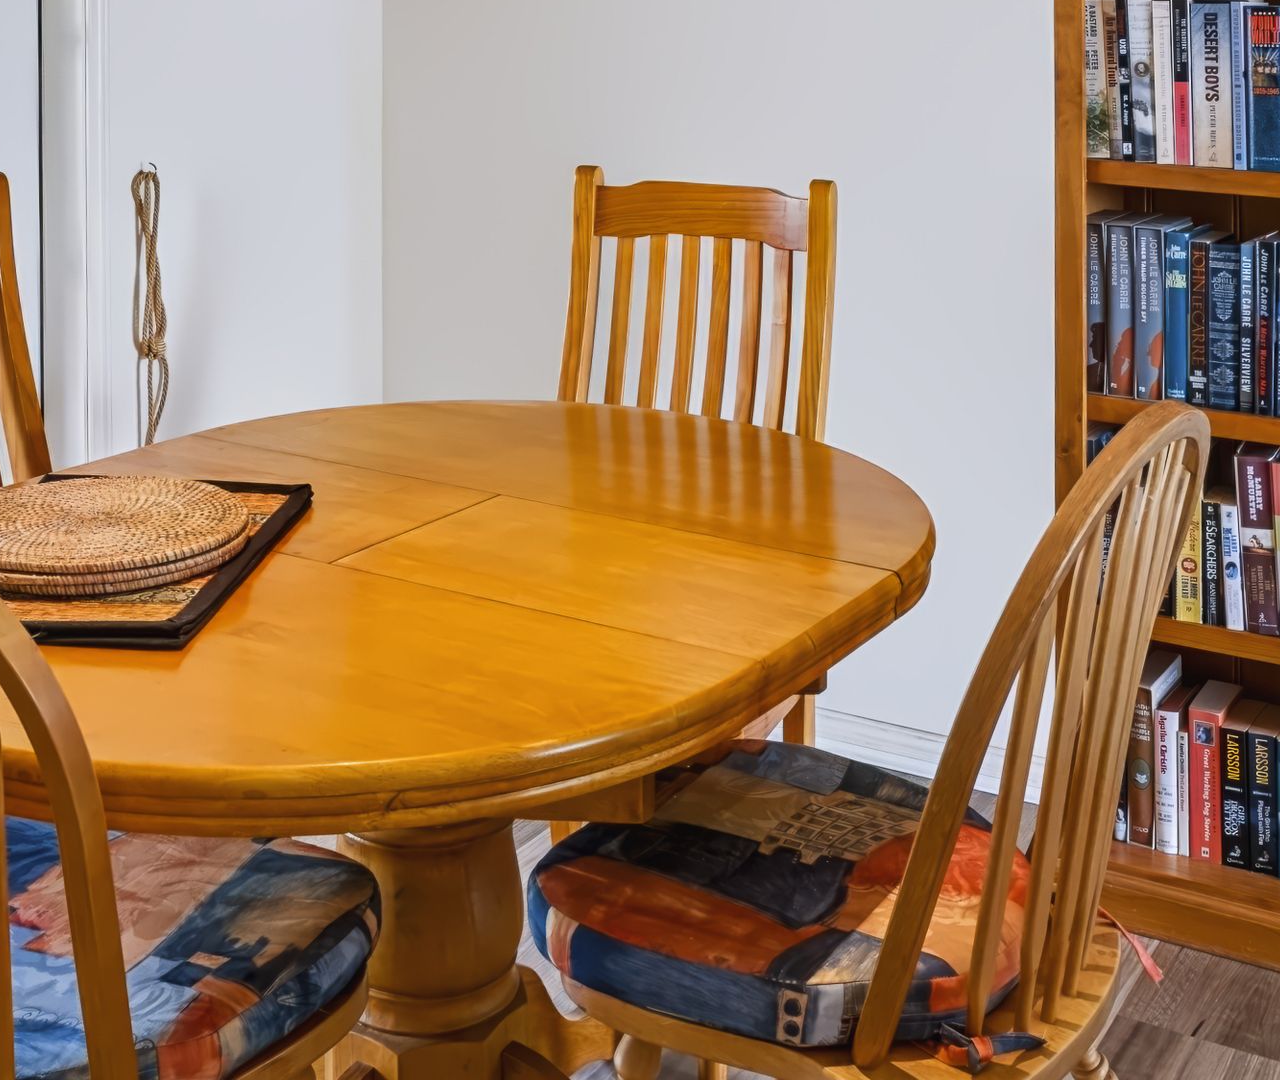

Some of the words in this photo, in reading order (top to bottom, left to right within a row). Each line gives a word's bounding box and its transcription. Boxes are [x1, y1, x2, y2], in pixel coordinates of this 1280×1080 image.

[1204, 12, 1218, 64] DESERT
[1205, 66, 1219, 102] BOYS
[1090, 234, 1098, 257] JOHN
[1120, 235, 1128, 260] JOHN
[1261, 249, 1269, 273] JOHN
[1242, 257, 1251, 282] JOHN
[1242, 338, 1251, 393] SILVERVIEW
[1254, 477, 1263, 511] LARRY
[1206, 520, 1217, 580] SEARCHERS
[1227, 734, 1240, 780] LARSSON
[1255, 738, 1268, 785] LARSSON
